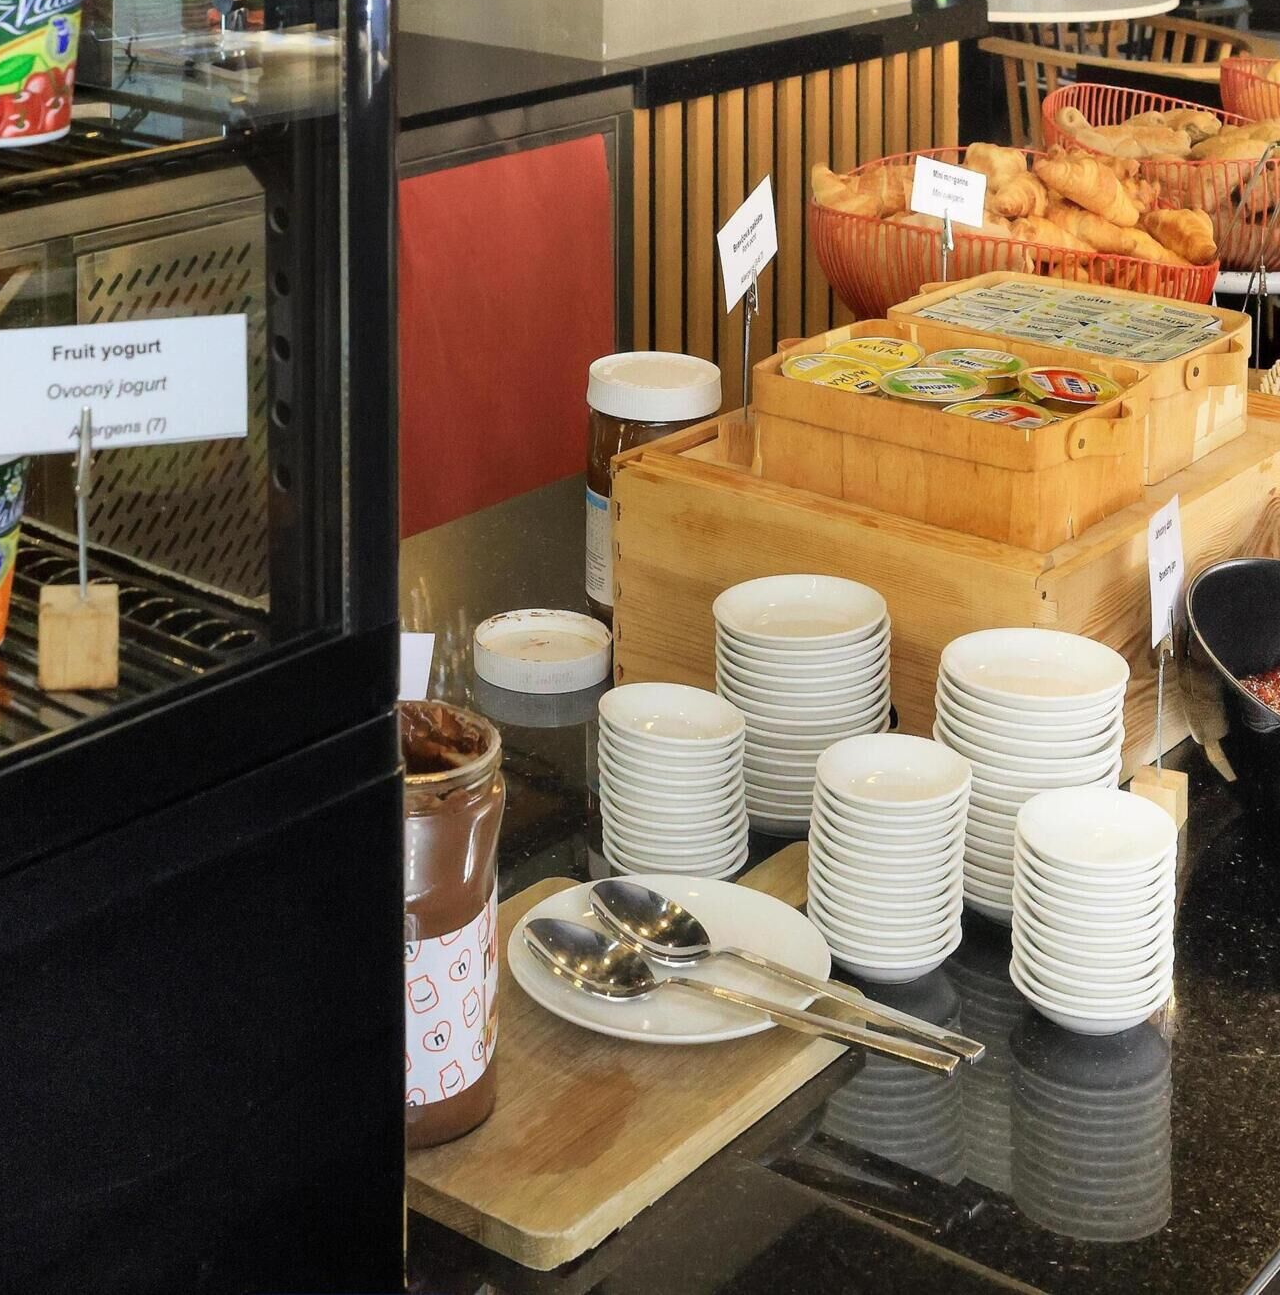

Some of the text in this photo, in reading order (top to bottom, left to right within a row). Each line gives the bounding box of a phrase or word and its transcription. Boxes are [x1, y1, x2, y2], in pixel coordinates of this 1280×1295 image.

[52, 340, 162, 361] Fruit yogurt
[47, 377, 167, 400] Ovocný jogurt
[68, 417, 167, 440] Aergens (7)
[433, 1033, 446, 1046] n
